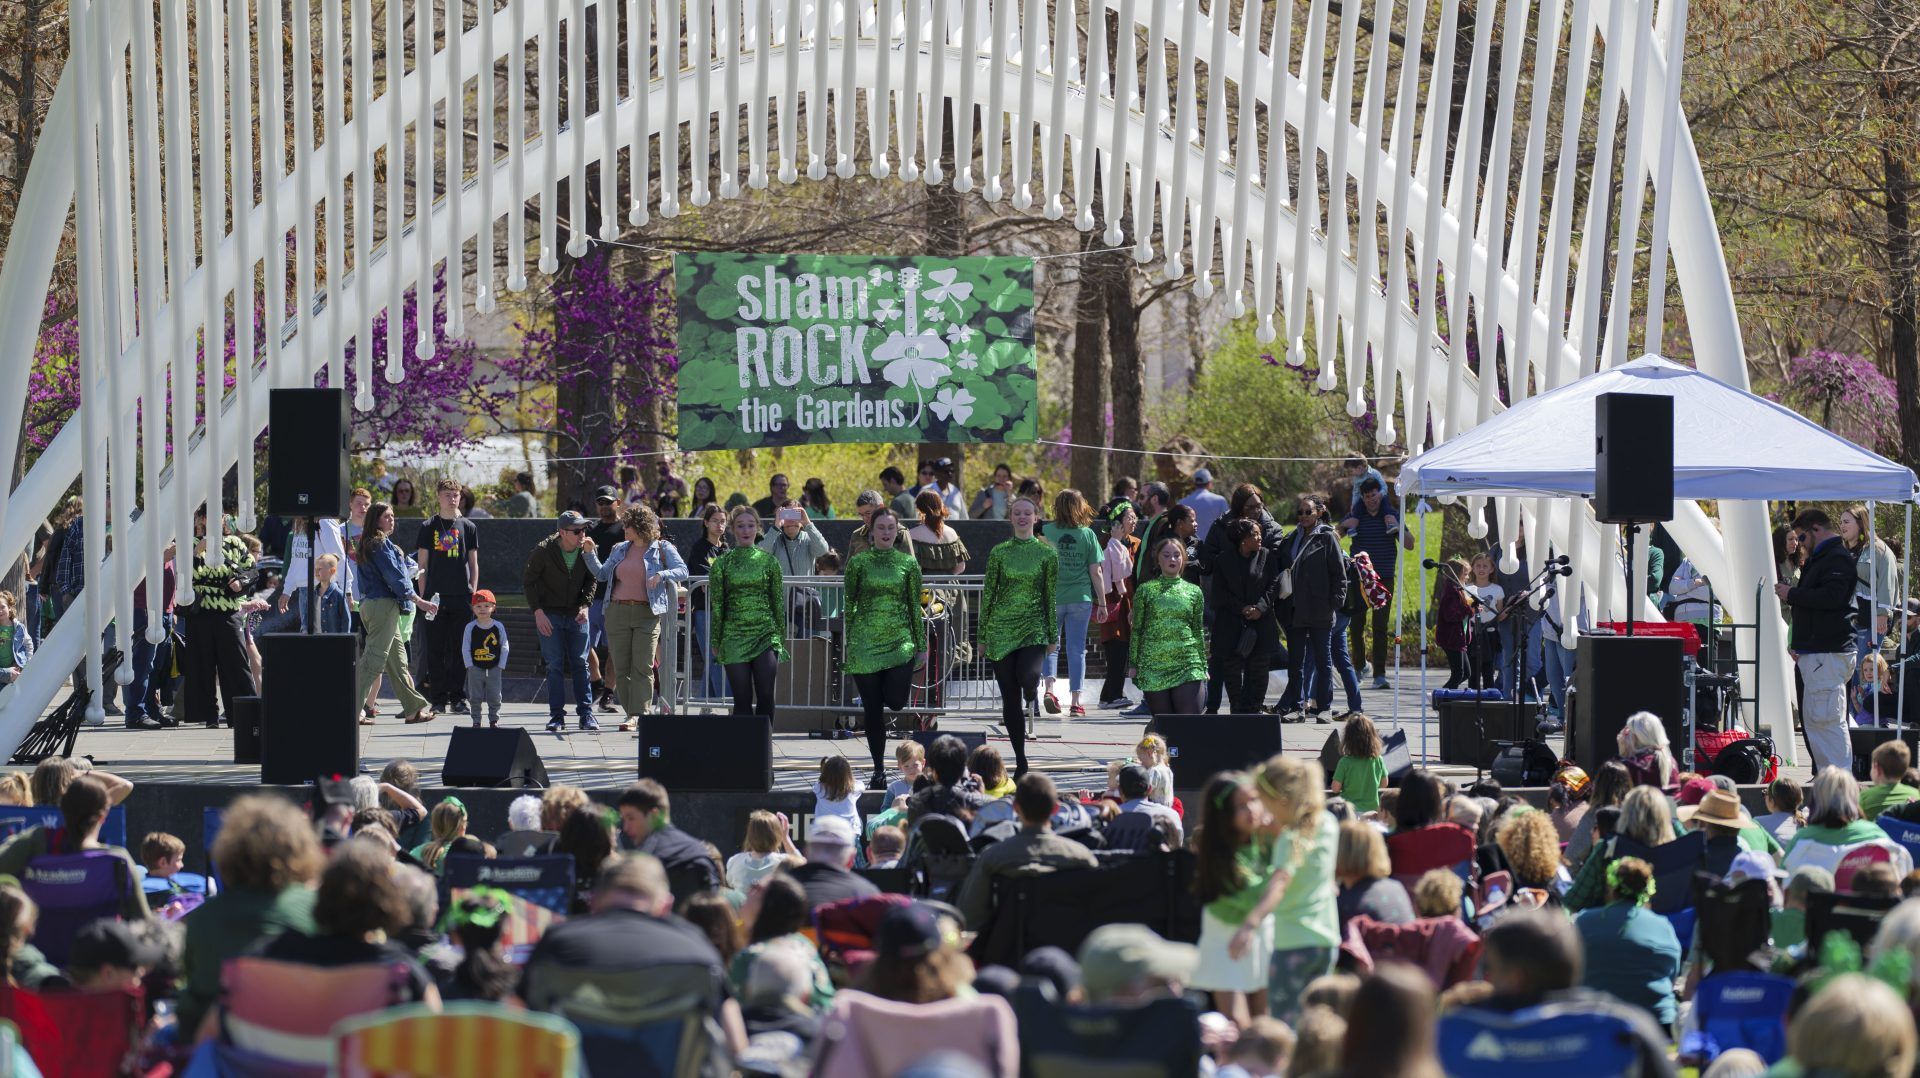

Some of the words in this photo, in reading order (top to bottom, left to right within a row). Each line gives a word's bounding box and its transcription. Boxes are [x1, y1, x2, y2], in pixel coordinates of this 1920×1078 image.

[737, 265, 868, 320] sham
[736, 323, 872, 388] ROCK
[738, 397, 783, 433] the
[797, 391, 905, 430] Gardens
